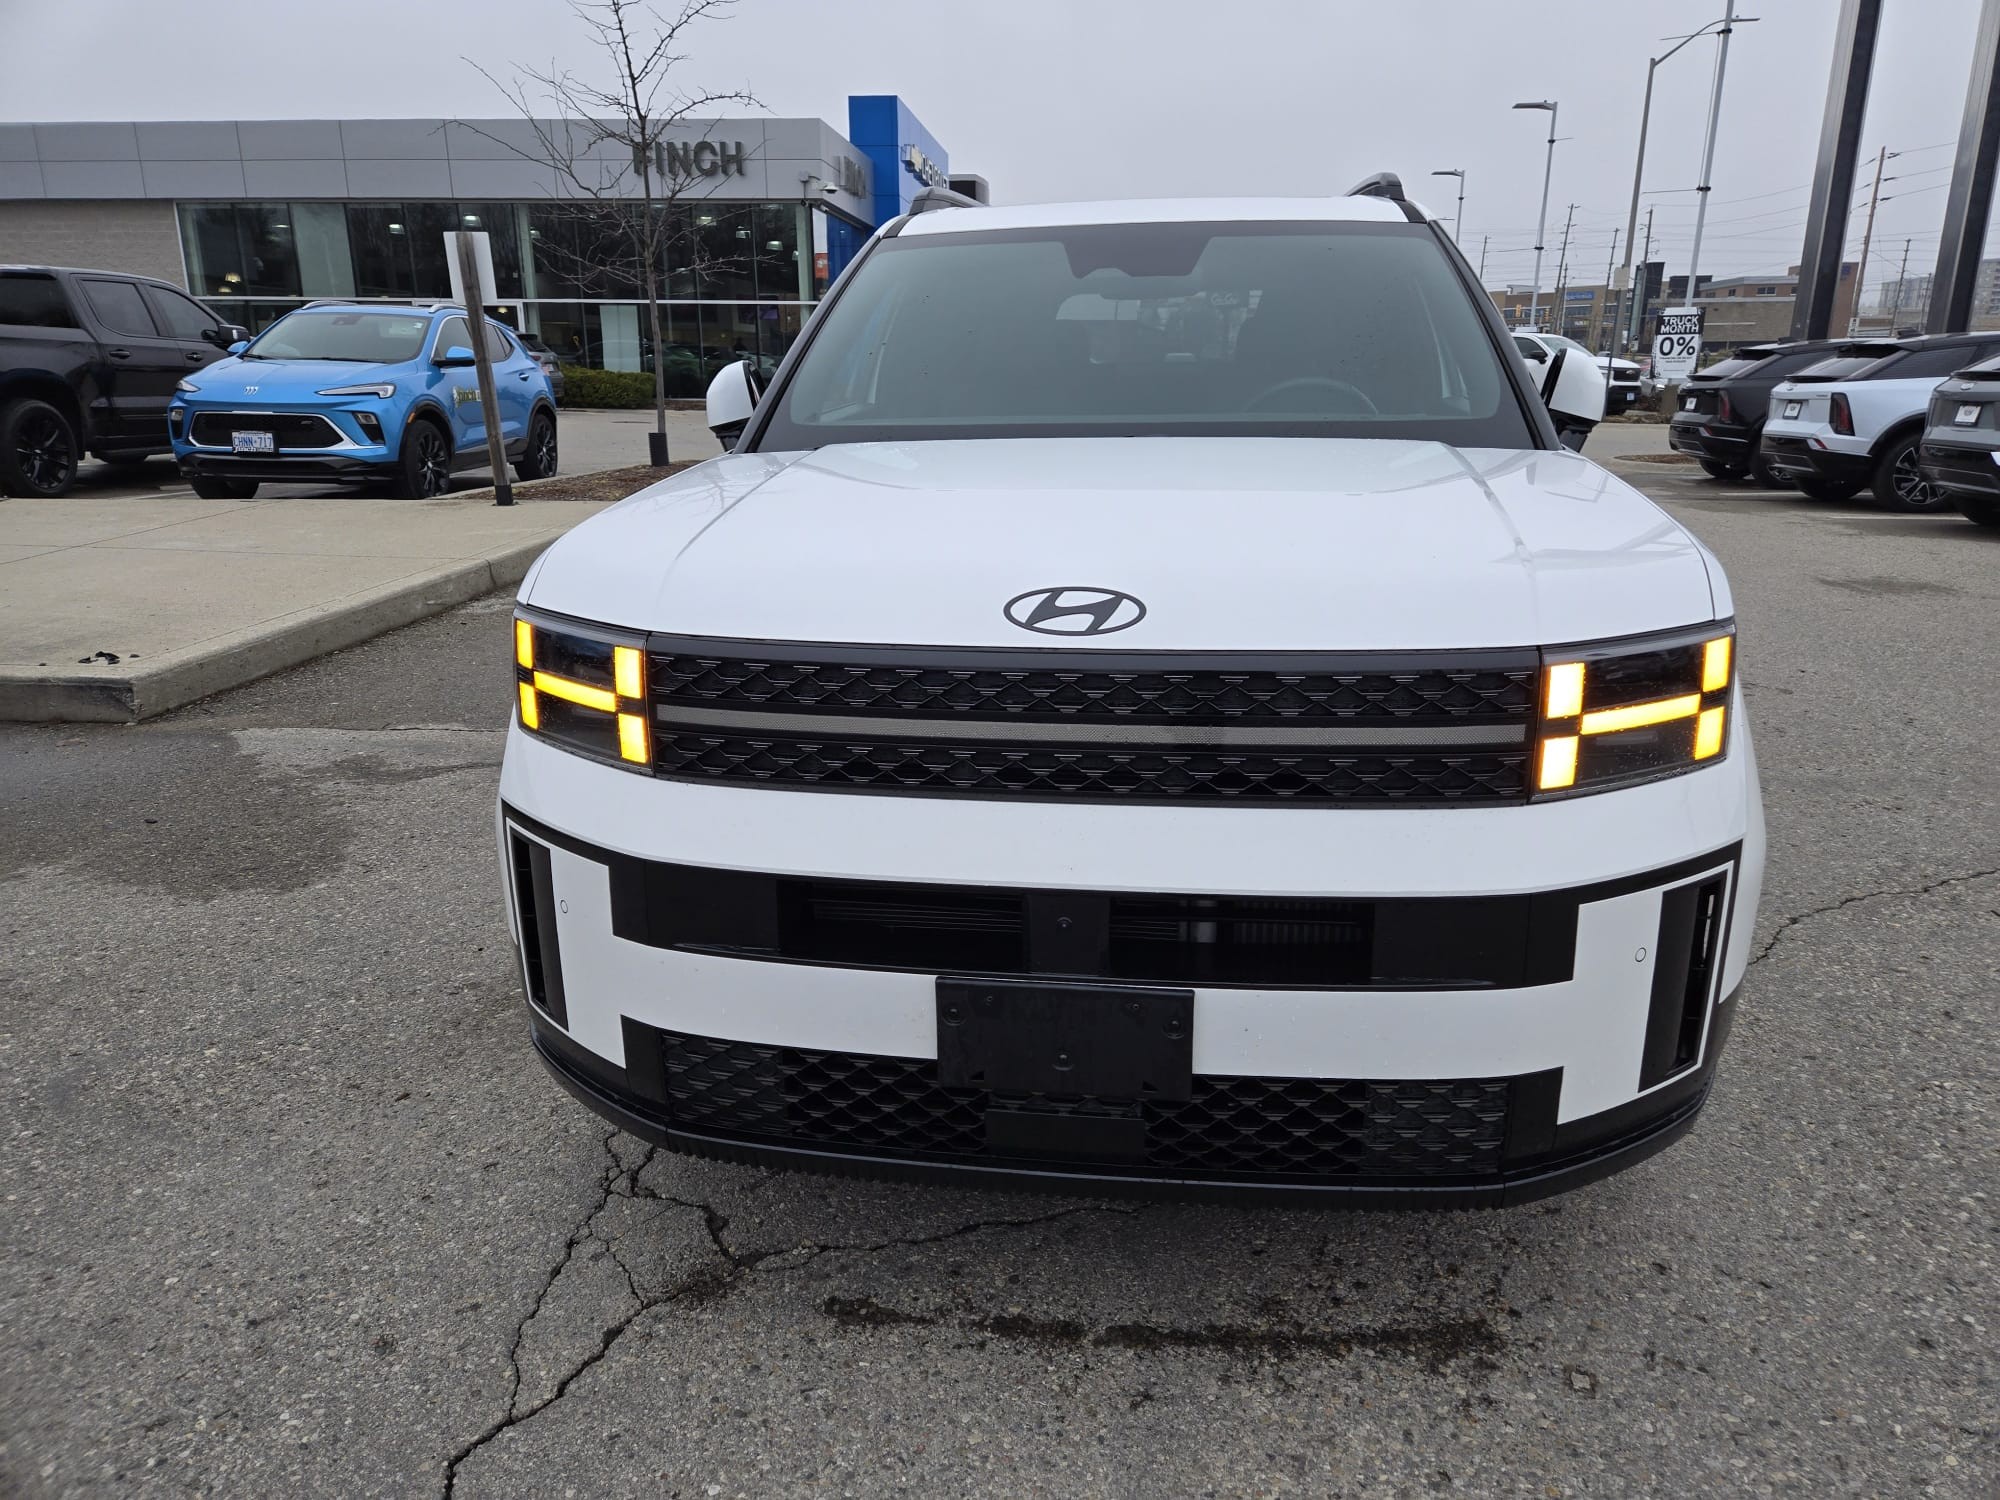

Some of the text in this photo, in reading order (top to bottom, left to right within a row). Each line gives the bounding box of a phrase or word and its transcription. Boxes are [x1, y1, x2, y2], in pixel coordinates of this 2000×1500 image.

[632, 141, 744, 176] FINCH
[1663, 315, 1699, 326] TRUCK
[1660, 324, 1699, 334] MONTH
[1659, 336, 1696, 356] 0%
